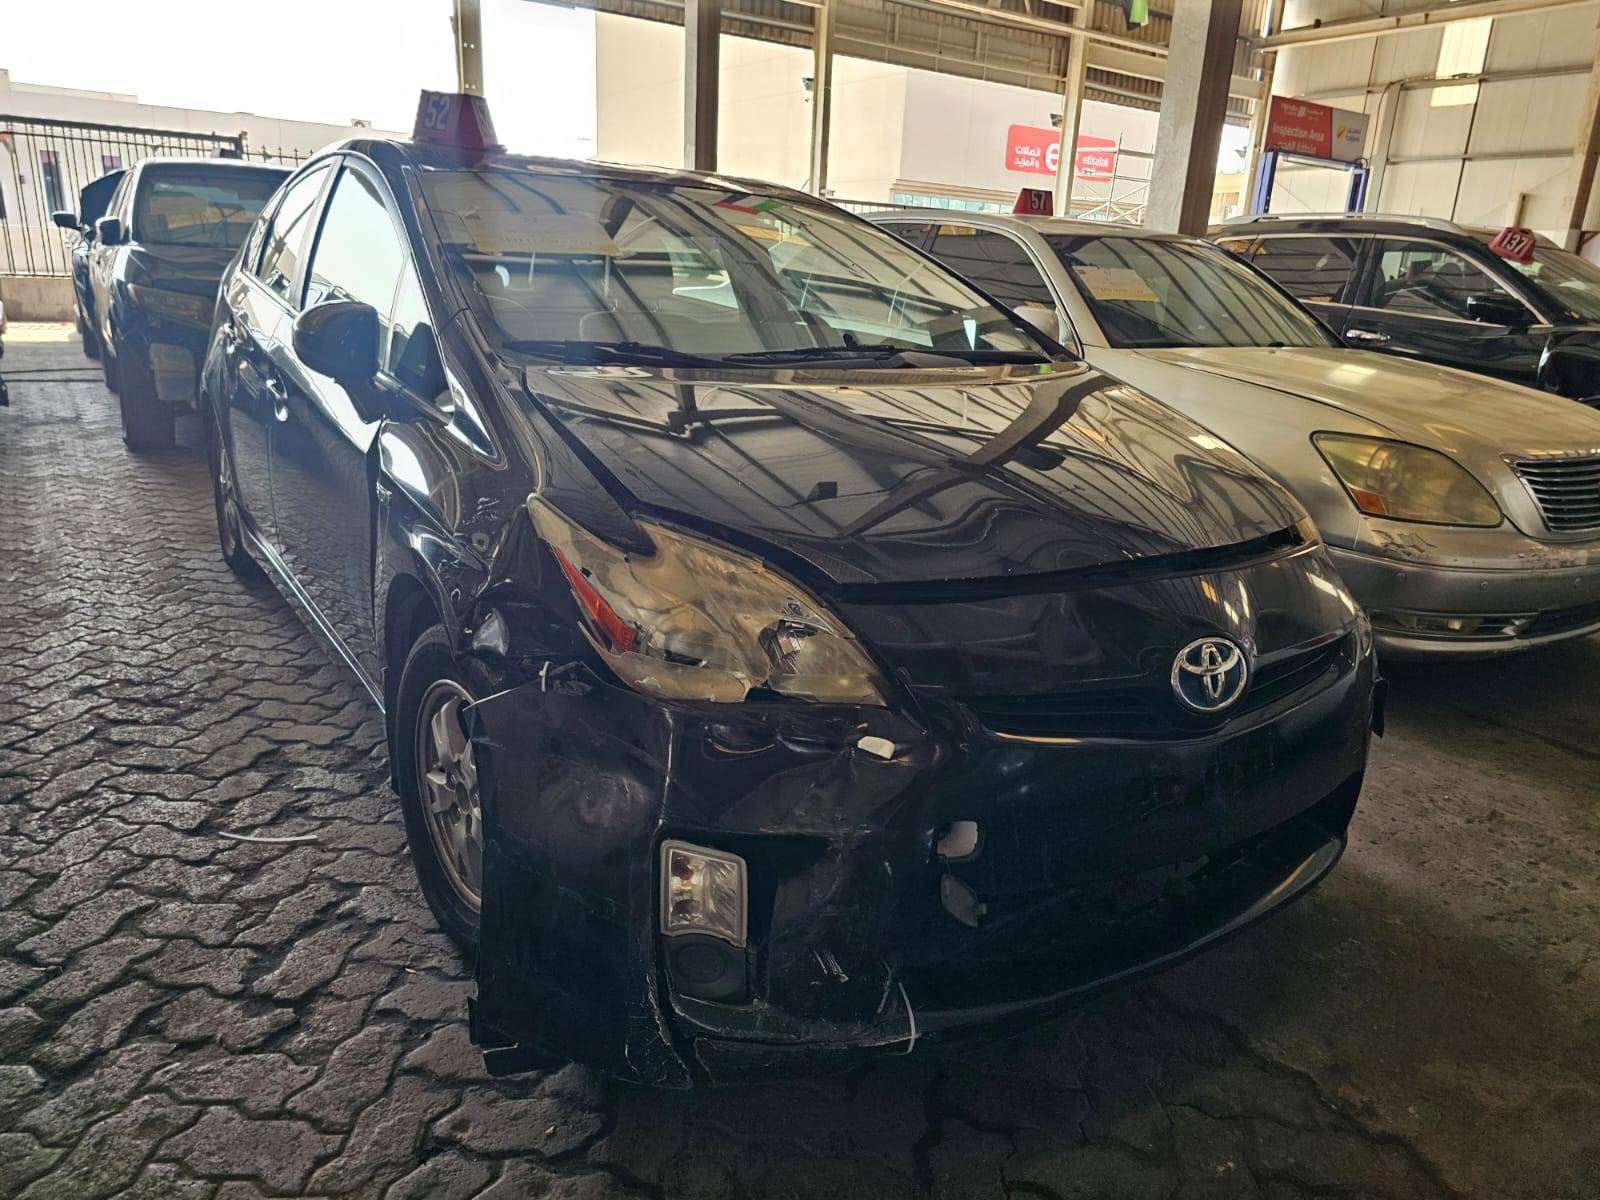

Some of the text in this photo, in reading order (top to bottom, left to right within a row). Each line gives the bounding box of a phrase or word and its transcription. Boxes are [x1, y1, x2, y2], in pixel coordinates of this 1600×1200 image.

[424, 94, 451, 129] 52
[1272, 122, 1325, 142] Inspection Area
[1015, 145, 1041, 157] اتصالات
[1082, 155, 1109, 168] etisalat
[1031, 190, 1046, 210] 57
[1501, 232, 1529, 253] 137
